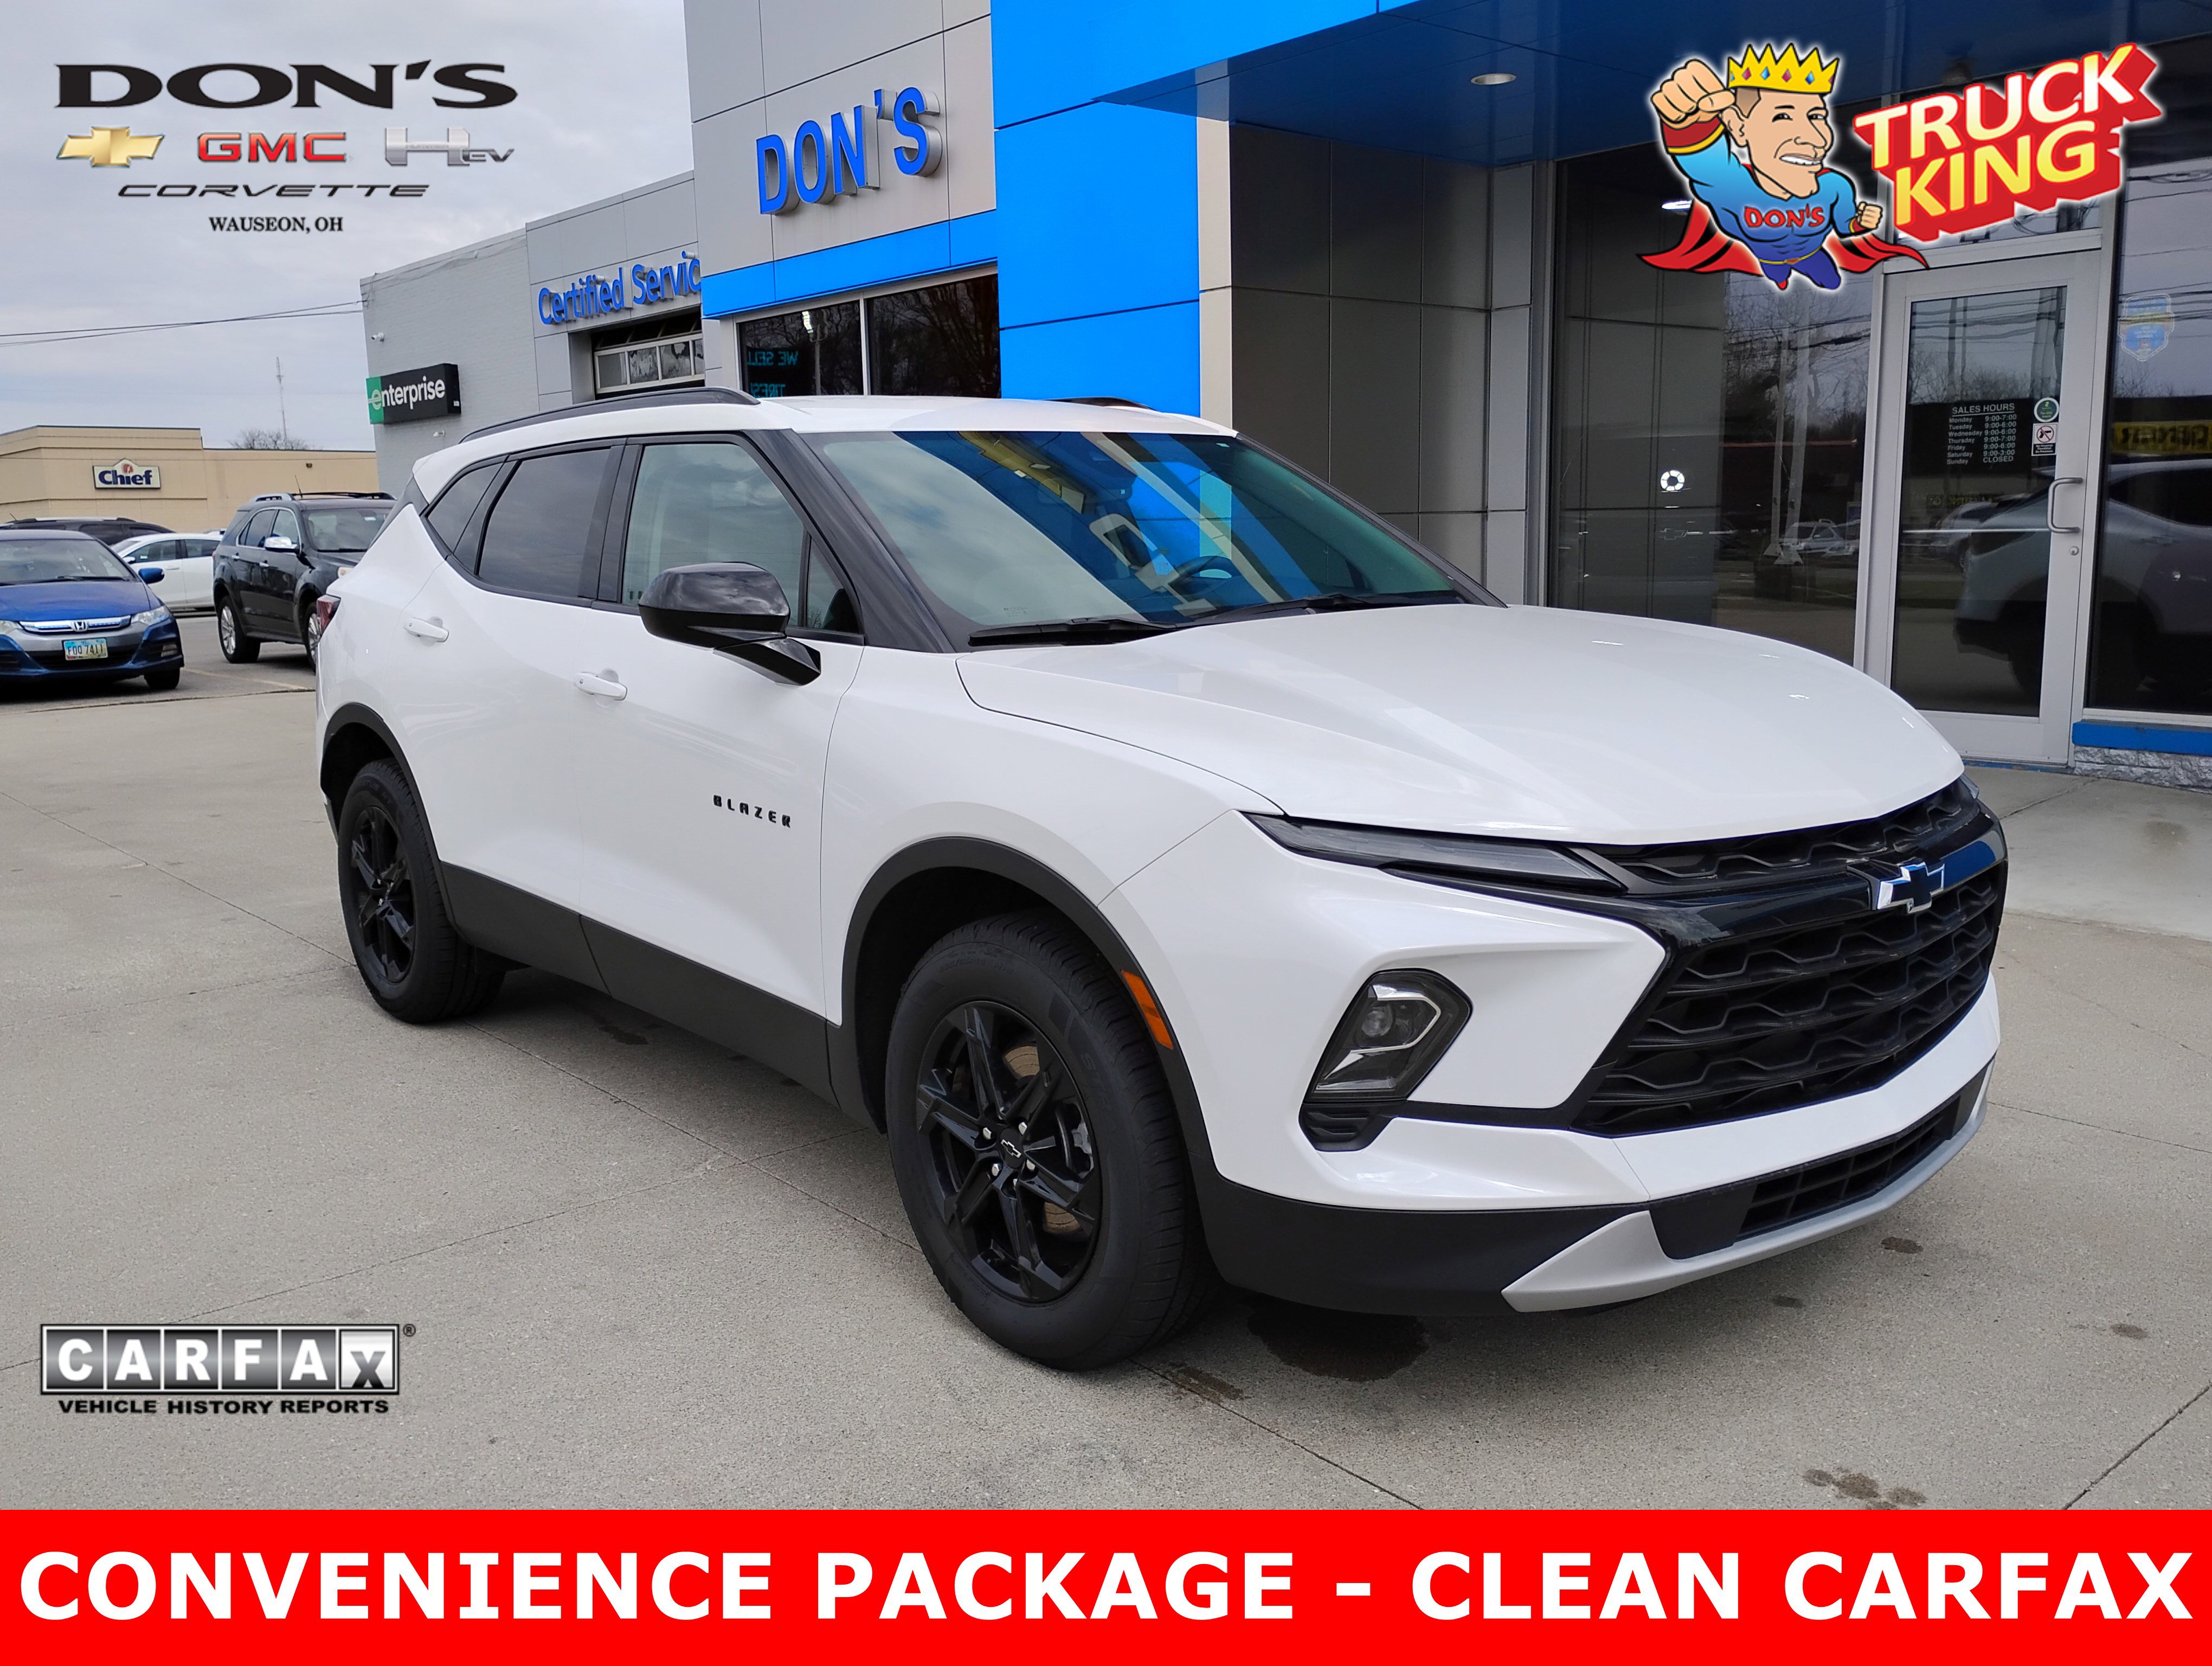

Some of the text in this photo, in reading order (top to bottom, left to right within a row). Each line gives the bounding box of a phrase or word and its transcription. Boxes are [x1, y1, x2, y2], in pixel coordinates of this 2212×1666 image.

[756, 87, 938, 215] DON'S
[538, 267, 625, 325] Certified
[368, 375, 445, 410] enterprise
[1952, 403, 2015, 414] SALES HOURS
[98, 470, 152, 485] Chief
[712, 794, 791, 828] BLAZER
